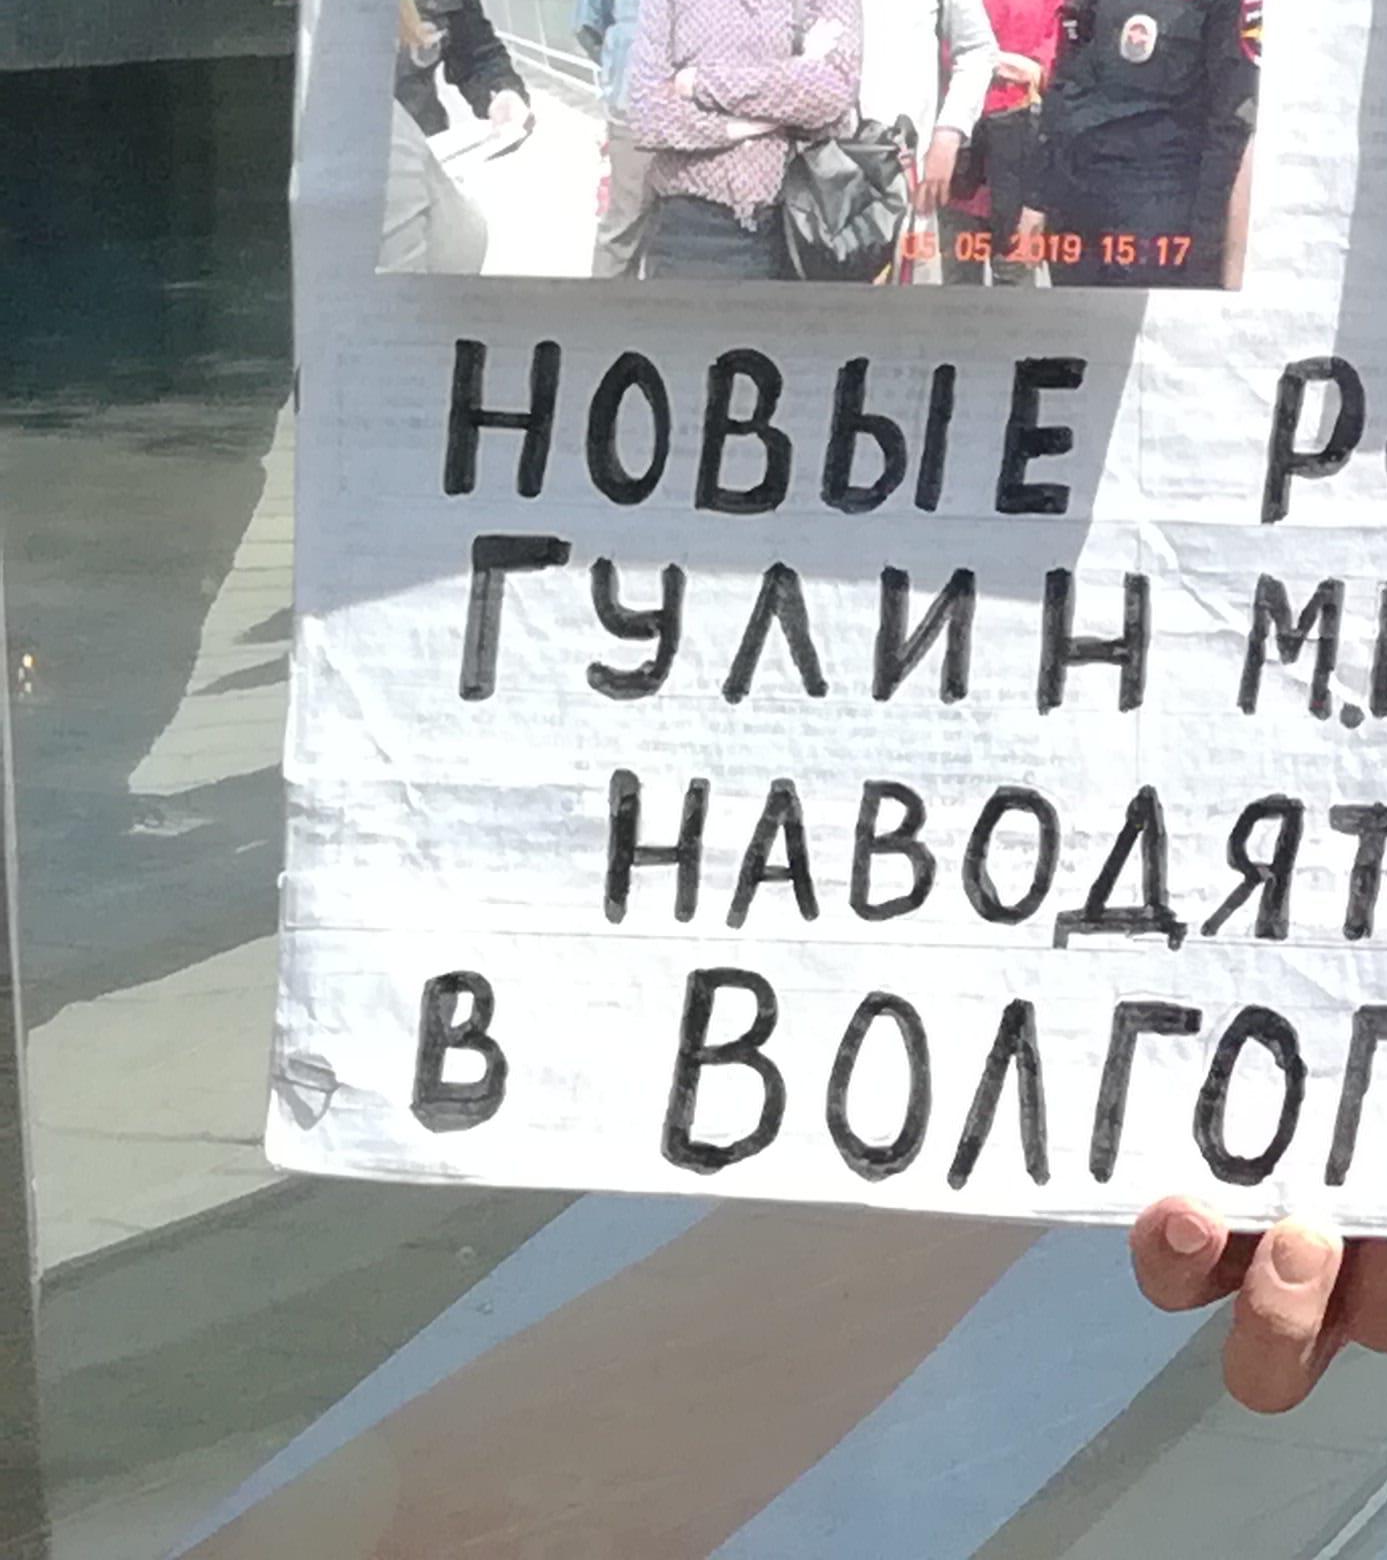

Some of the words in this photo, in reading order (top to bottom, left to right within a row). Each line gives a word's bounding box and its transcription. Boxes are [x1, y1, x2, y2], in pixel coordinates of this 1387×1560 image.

[1005, 233, 1083, 264] 2019
[443, 338, 1087, 515] НОВЫЕ
[458, 534, 1148, 714] ГУЛИН
[411, 971, 508, 1133] В
